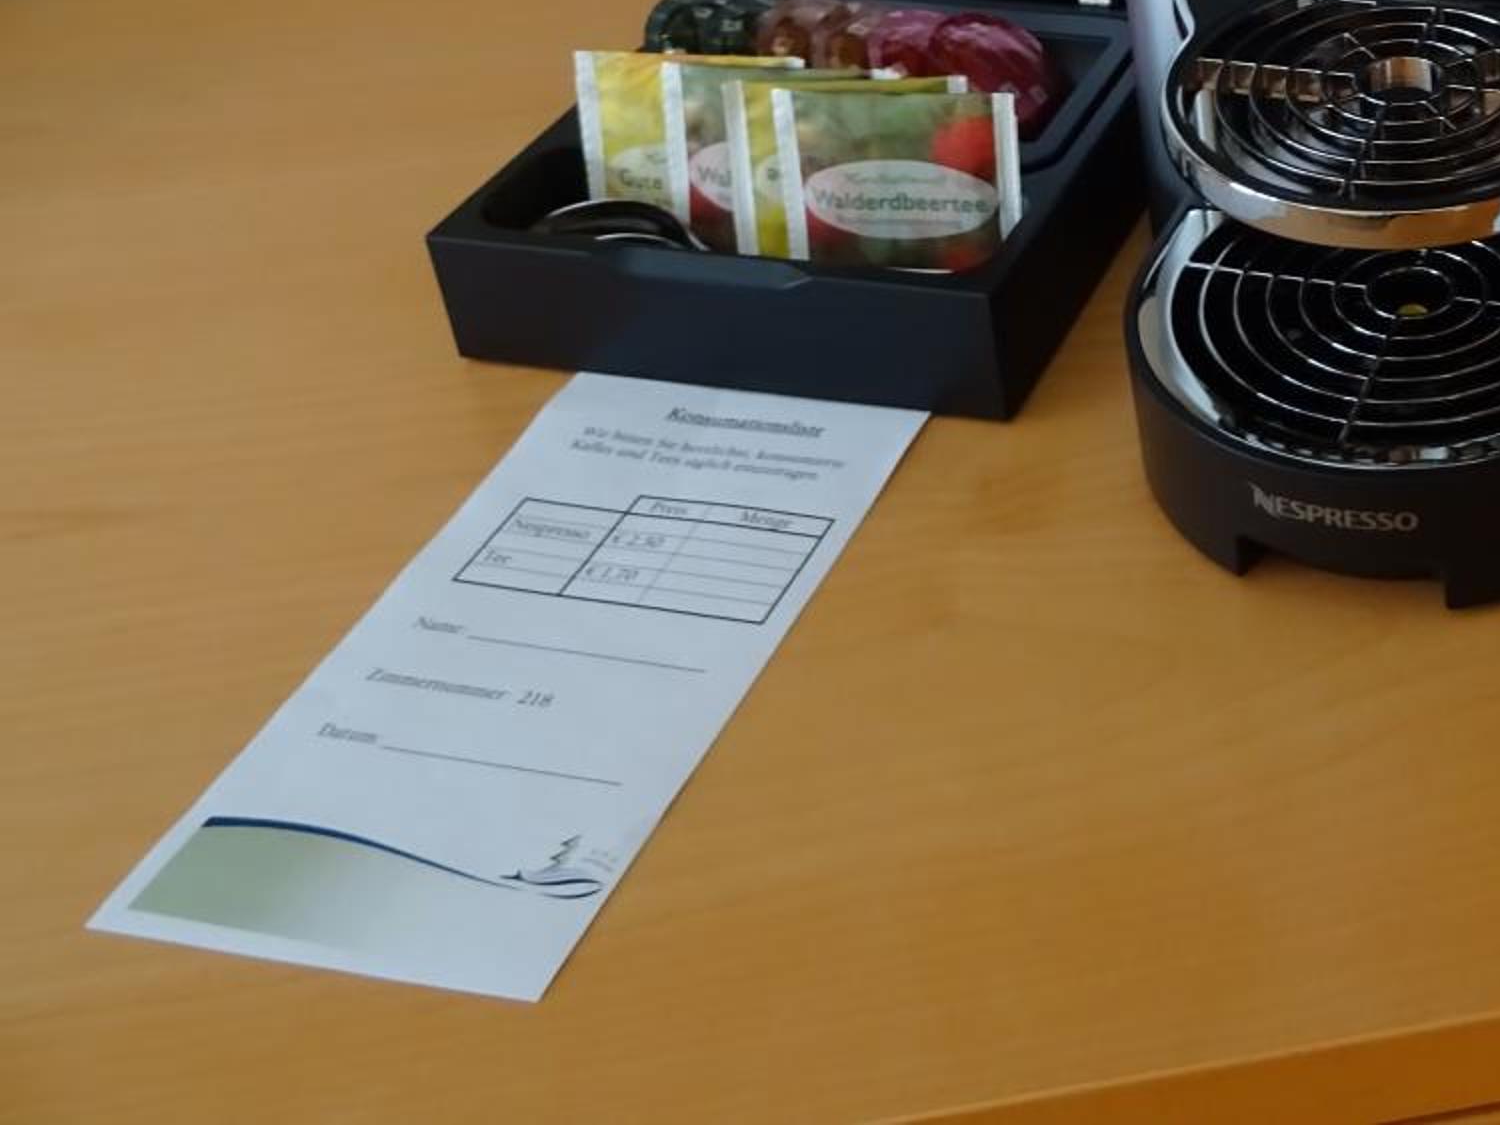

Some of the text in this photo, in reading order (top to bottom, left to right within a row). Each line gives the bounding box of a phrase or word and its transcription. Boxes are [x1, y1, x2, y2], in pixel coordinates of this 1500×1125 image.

[814, 189, 989, 214] Walderdbeertee
[1248, 480, 1420, 532] NESPRESSO
[413, 615, 465, 635] Name
[318, 722, 378, 745] Datum
